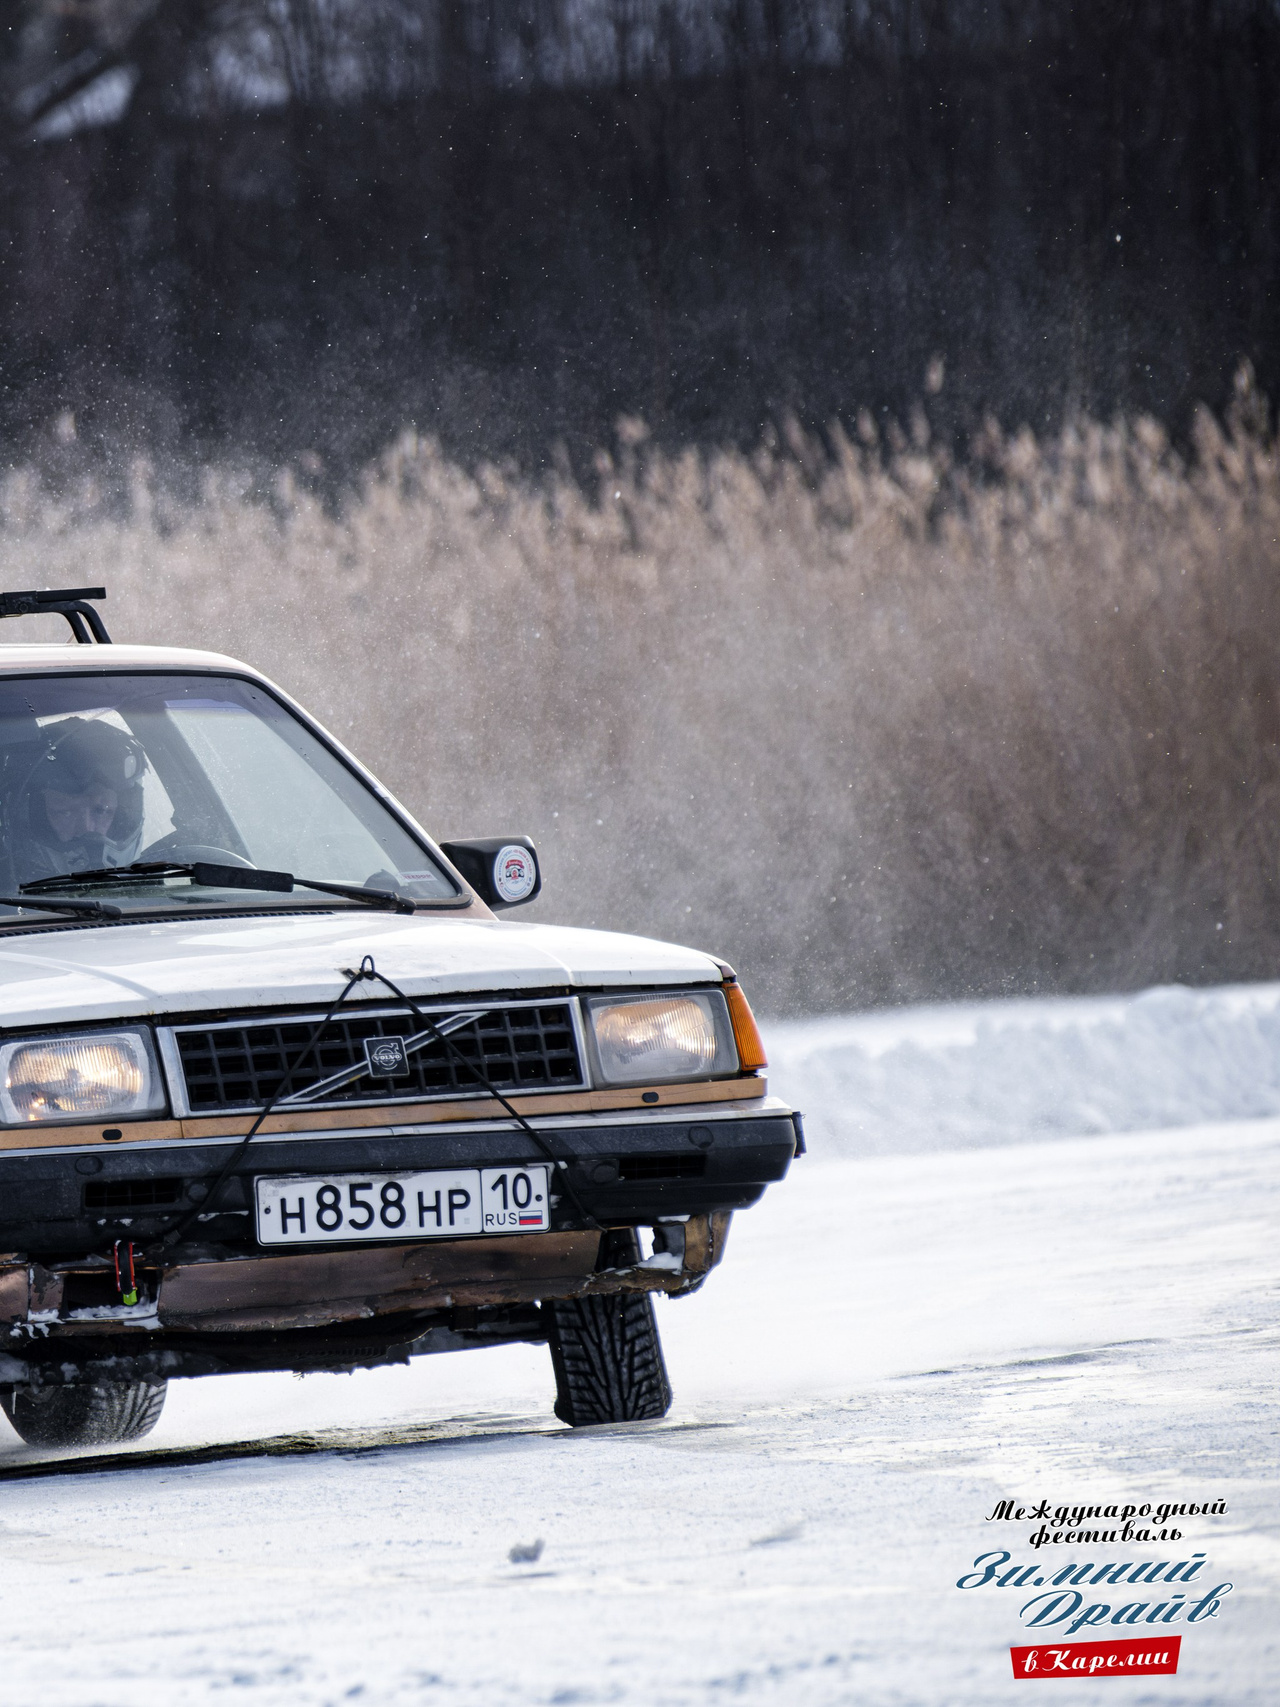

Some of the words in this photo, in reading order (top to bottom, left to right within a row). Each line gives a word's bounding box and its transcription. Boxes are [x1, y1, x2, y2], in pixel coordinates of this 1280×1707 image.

[280, 1181, 471, 1234] Н858НР
[491, 1173, 532, 1210] 10
[485, 1212, 517, 1226] RUS
